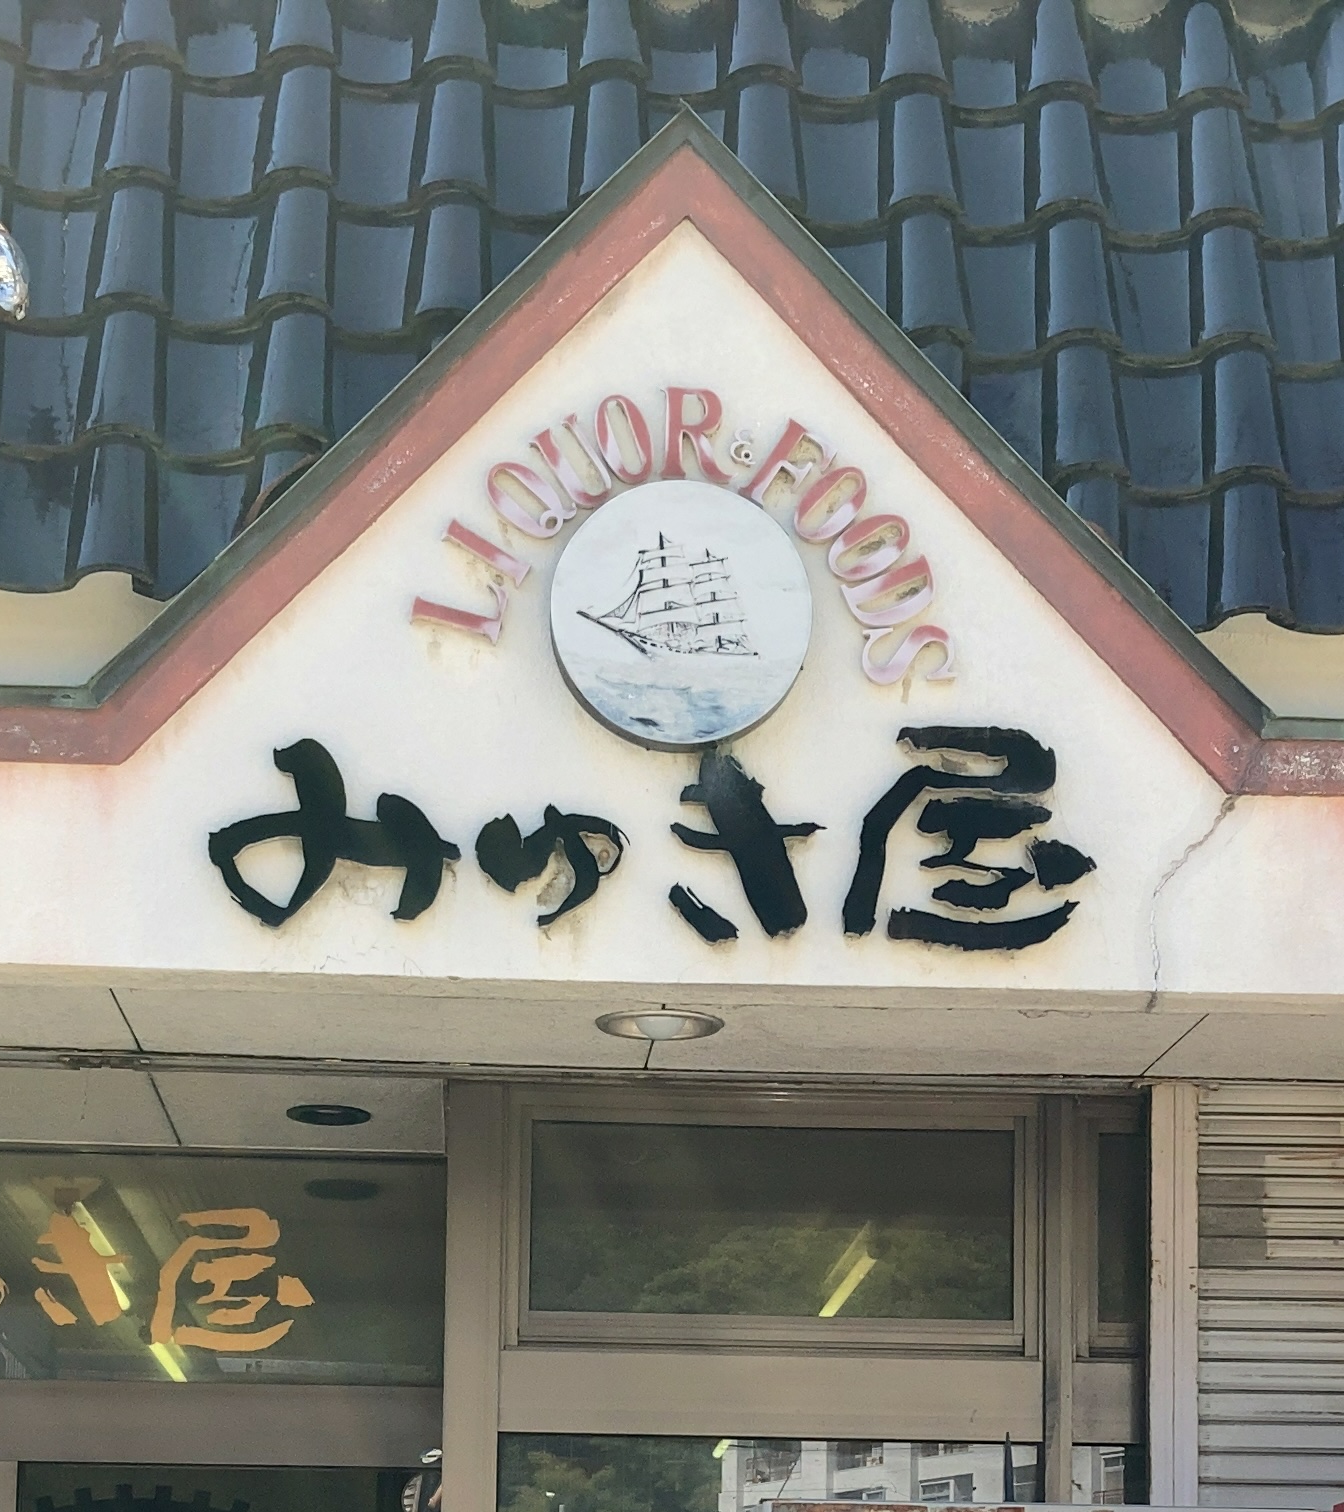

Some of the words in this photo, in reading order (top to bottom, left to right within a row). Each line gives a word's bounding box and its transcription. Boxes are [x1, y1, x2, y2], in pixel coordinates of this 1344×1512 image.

[409, 386, 733, 645] LIQUOR
[729, 429, 756, 468] &
[740, 416, 958, 685] FOODS
[207, 724, 1098, 950] みゆき屋
